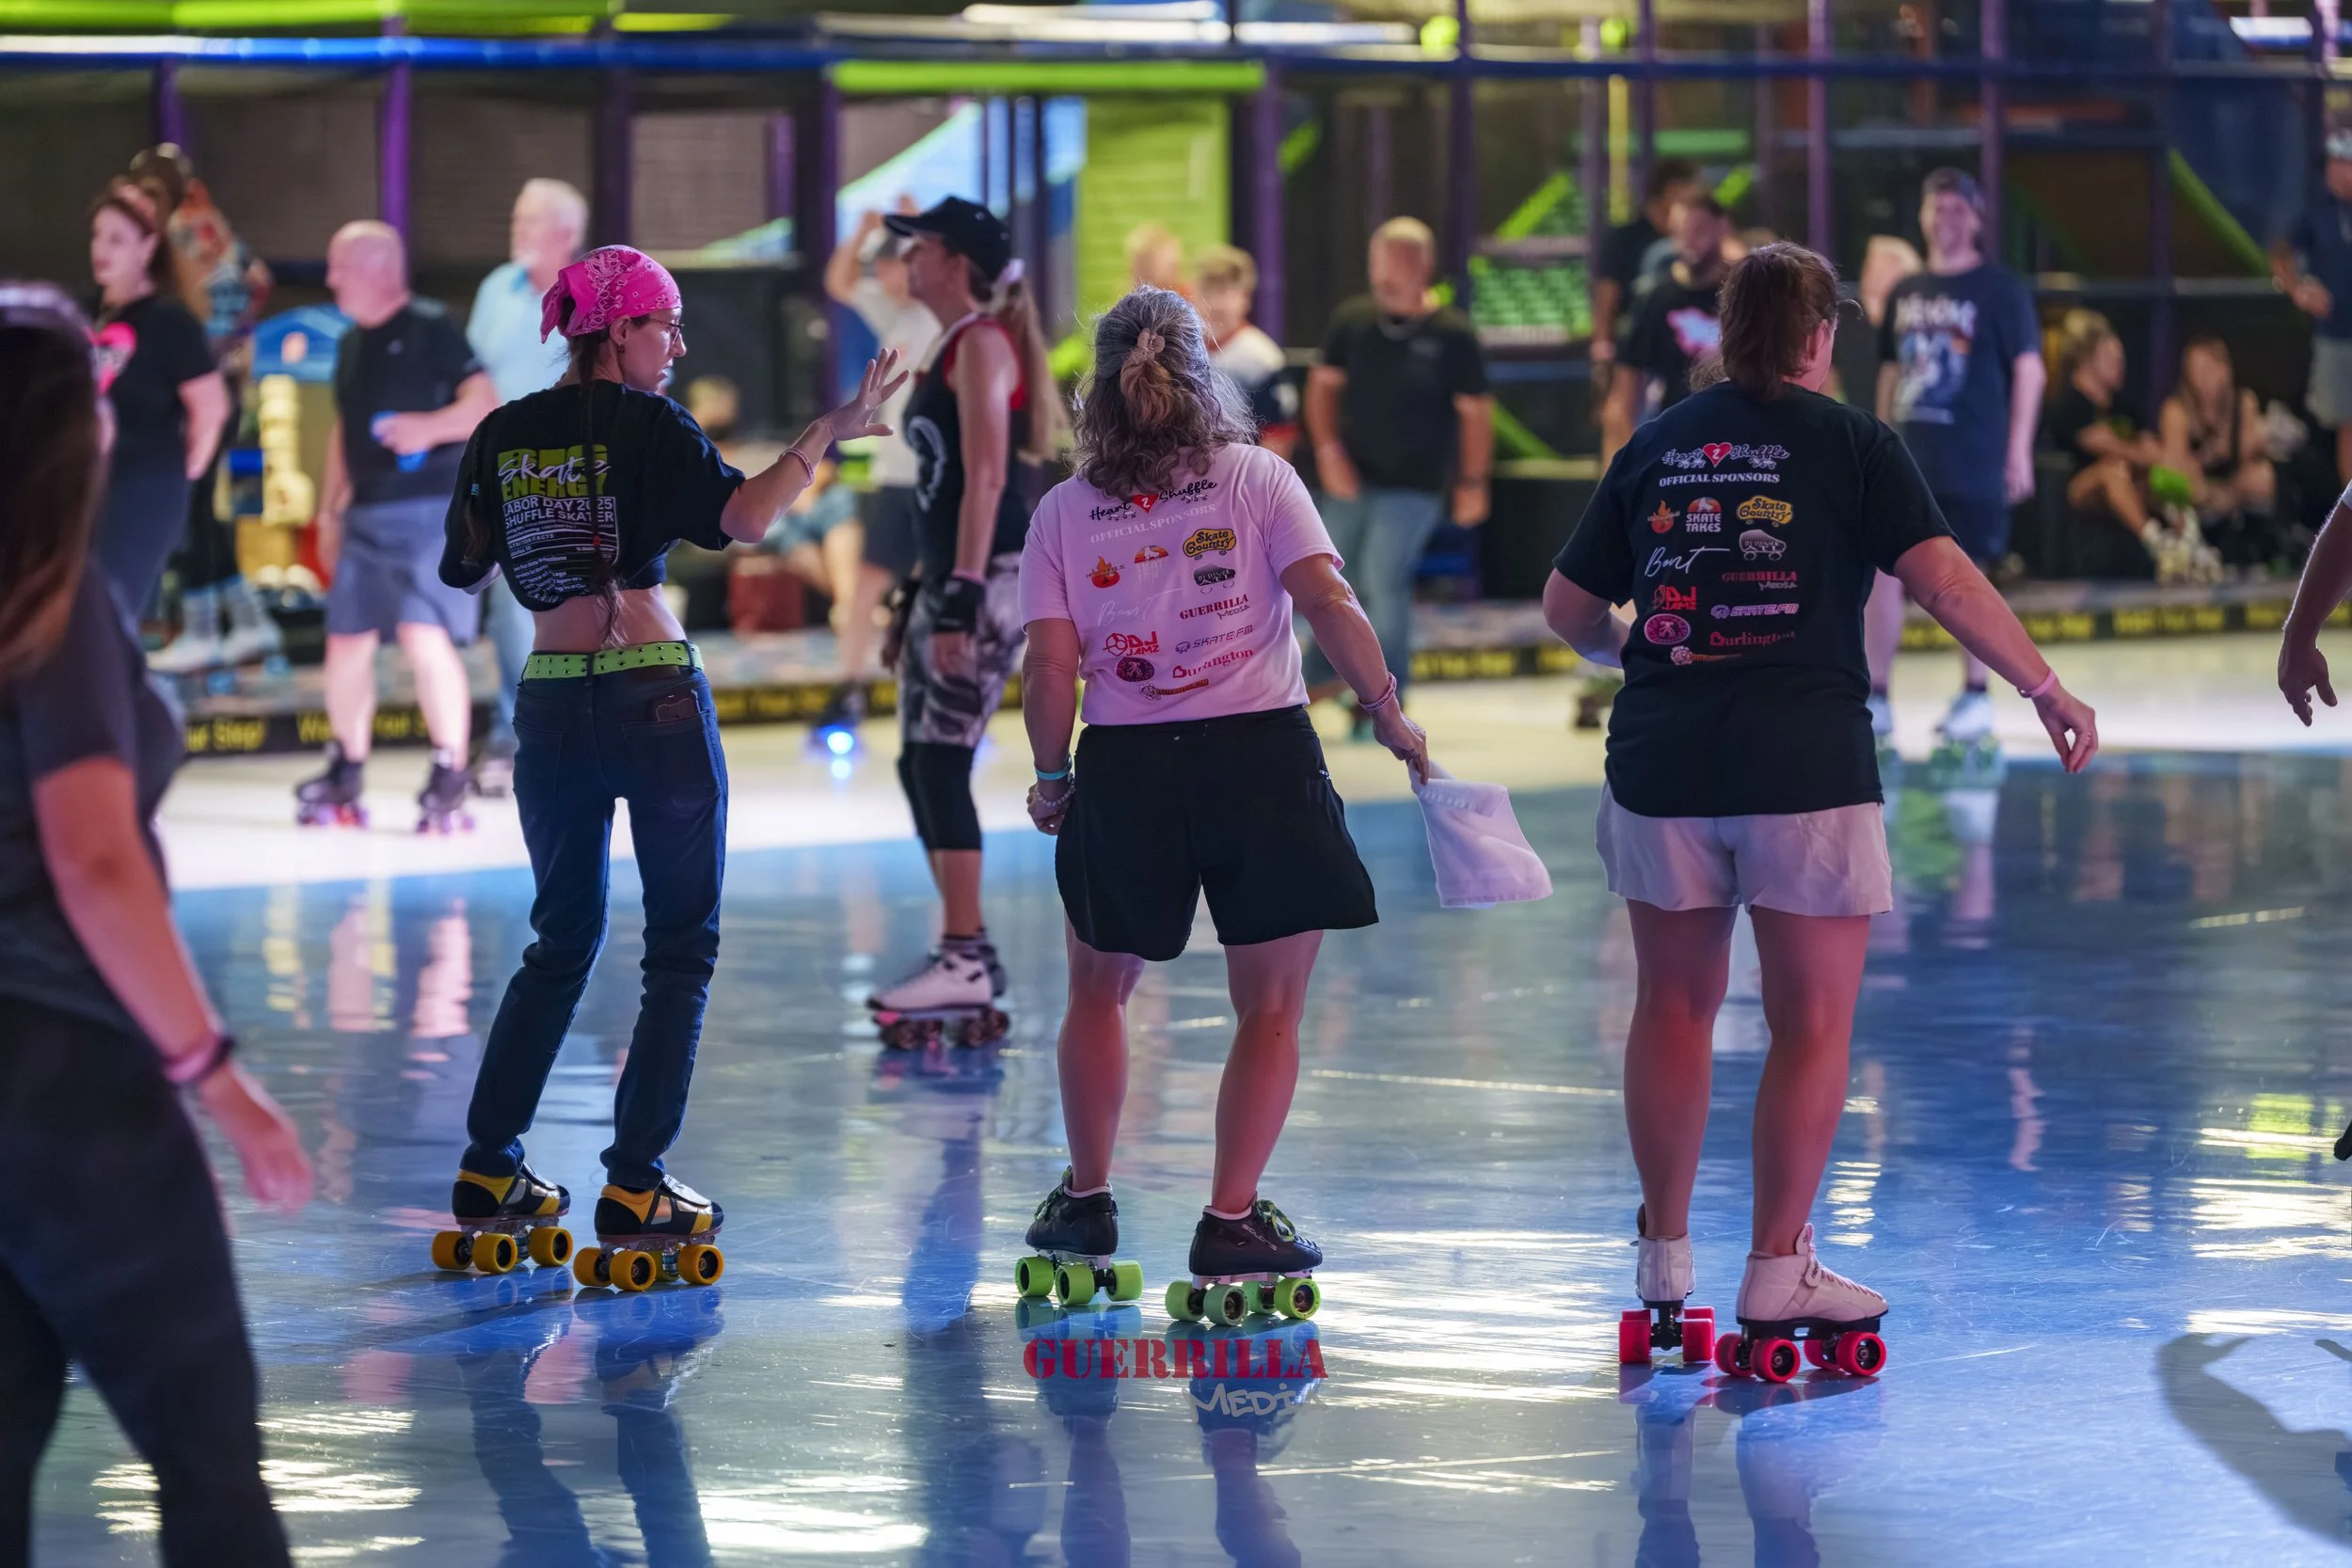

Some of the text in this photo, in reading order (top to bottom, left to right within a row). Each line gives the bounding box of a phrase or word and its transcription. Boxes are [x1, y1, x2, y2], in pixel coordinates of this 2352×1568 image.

[1730, 444, 1790, 460] Shuffle
[498, 453, 612, 484] Skate
[1659, 472, 1780, 487] OFFICIAL SPONSORS
[503, 498, 539, 517] LABOR
[543, 499, 573, 513] DAY
[1089, 502, 1132, 522] Heart
[1158, 479, 1217, 503] Shuffle
[1752, 497, 1788, 512] Skate
[505, 508, 555, 529] SHUFFLE
[557, 511, 614, 522] SKATER
[1686, 513, 1721, 523] SKATE
[1740, 506, 1790, 521] Country
[1090, 503, 1217, 545] OFFICIAL SPONSORS
[1686, 522, 1722, 533] TAKES
[1195, 529, 1229, 544] Skate
[1185, 536, 1234, 554] Country
[1666, 586, 1697, 602] DJ
[1179, 594, 1249, 621] GUERRILLA
[1128, 631, 1159, 649] DJ
[1126, 644, 1160, 657] JAMZ
